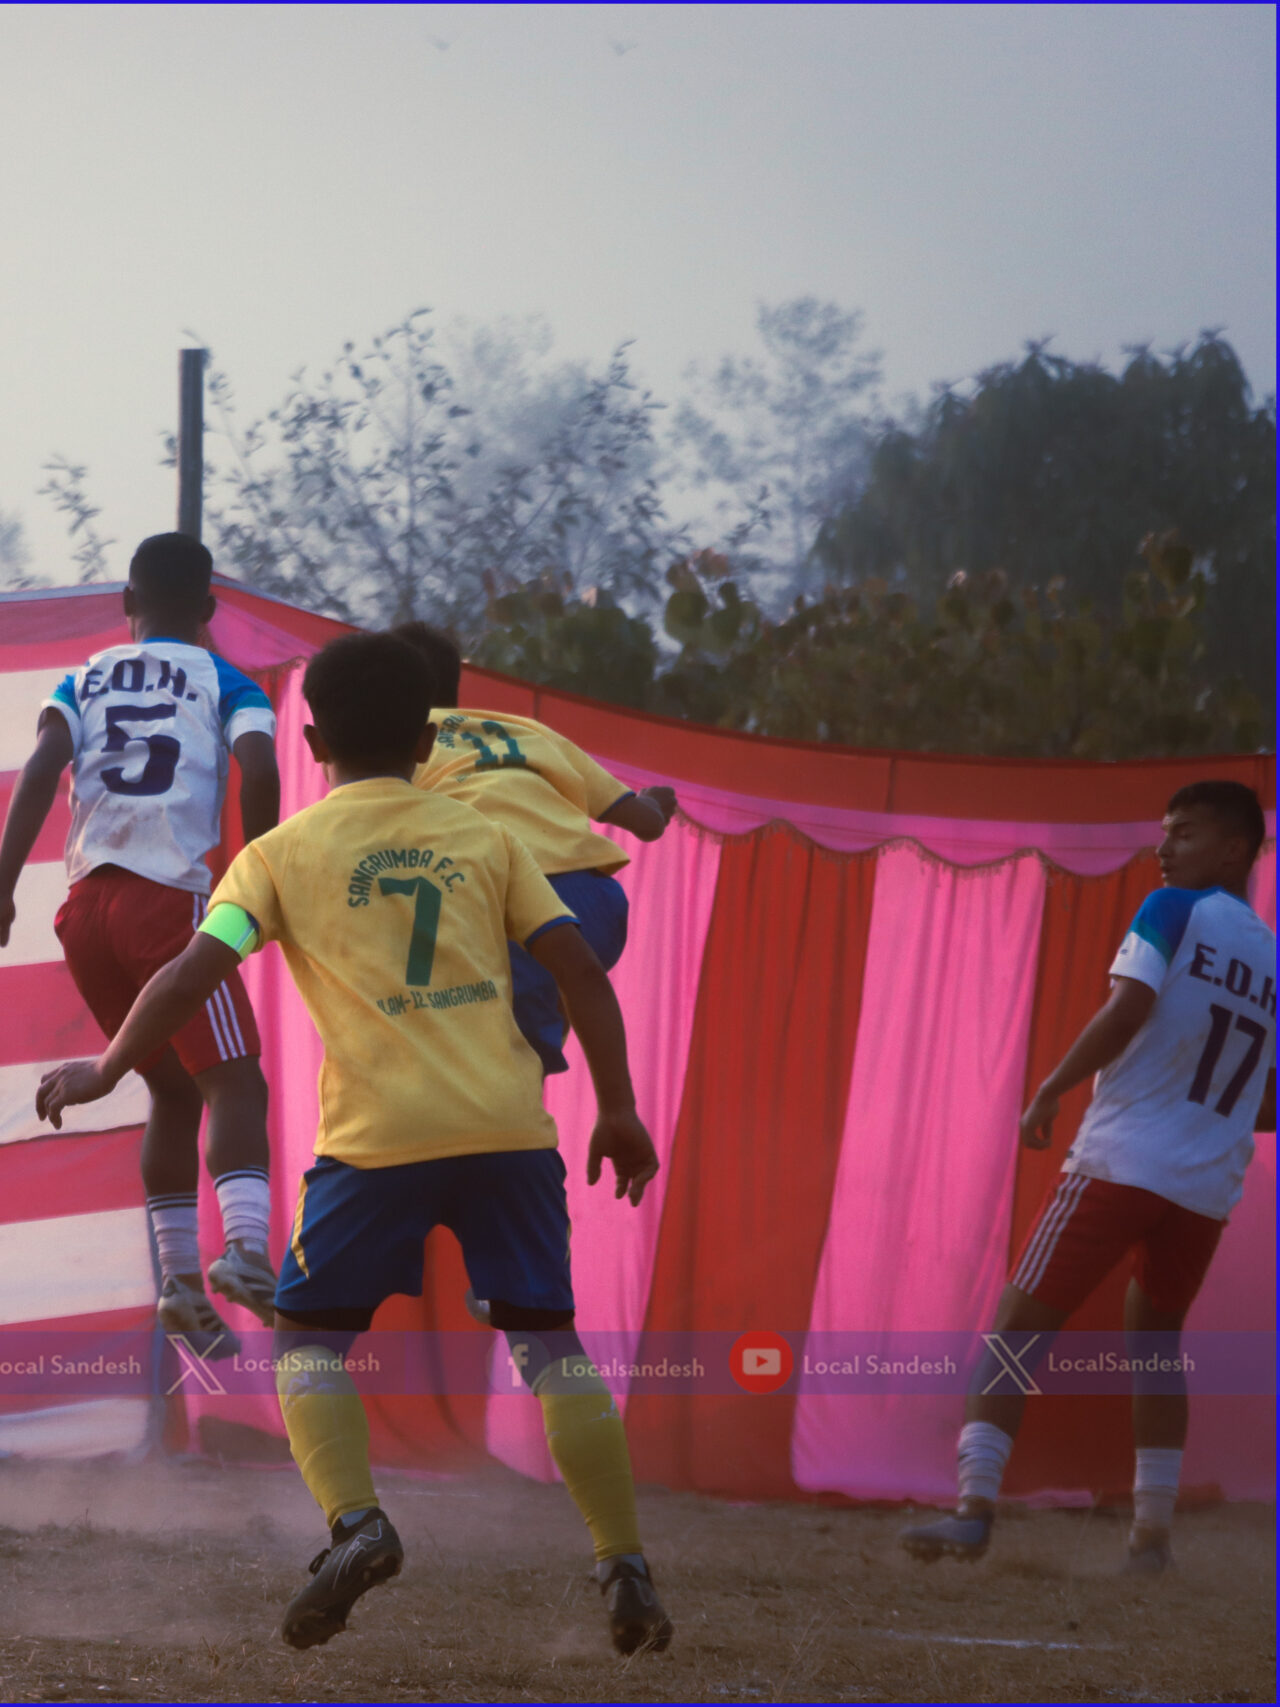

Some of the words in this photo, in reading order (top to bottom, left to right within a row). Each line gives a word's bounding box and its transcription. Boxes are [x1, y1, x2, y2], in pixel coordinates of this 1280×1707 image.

[80, 659, 198, 702] E.O.H.
[100, 703, 181, 797] 5
[347, 848, 434, 908] SANGRUMBA
[378, 876, 442, 986] 7
[428, 979, 498, 1009] SANGRUMBA
[1187, 1003, 1268, 1118] 17
